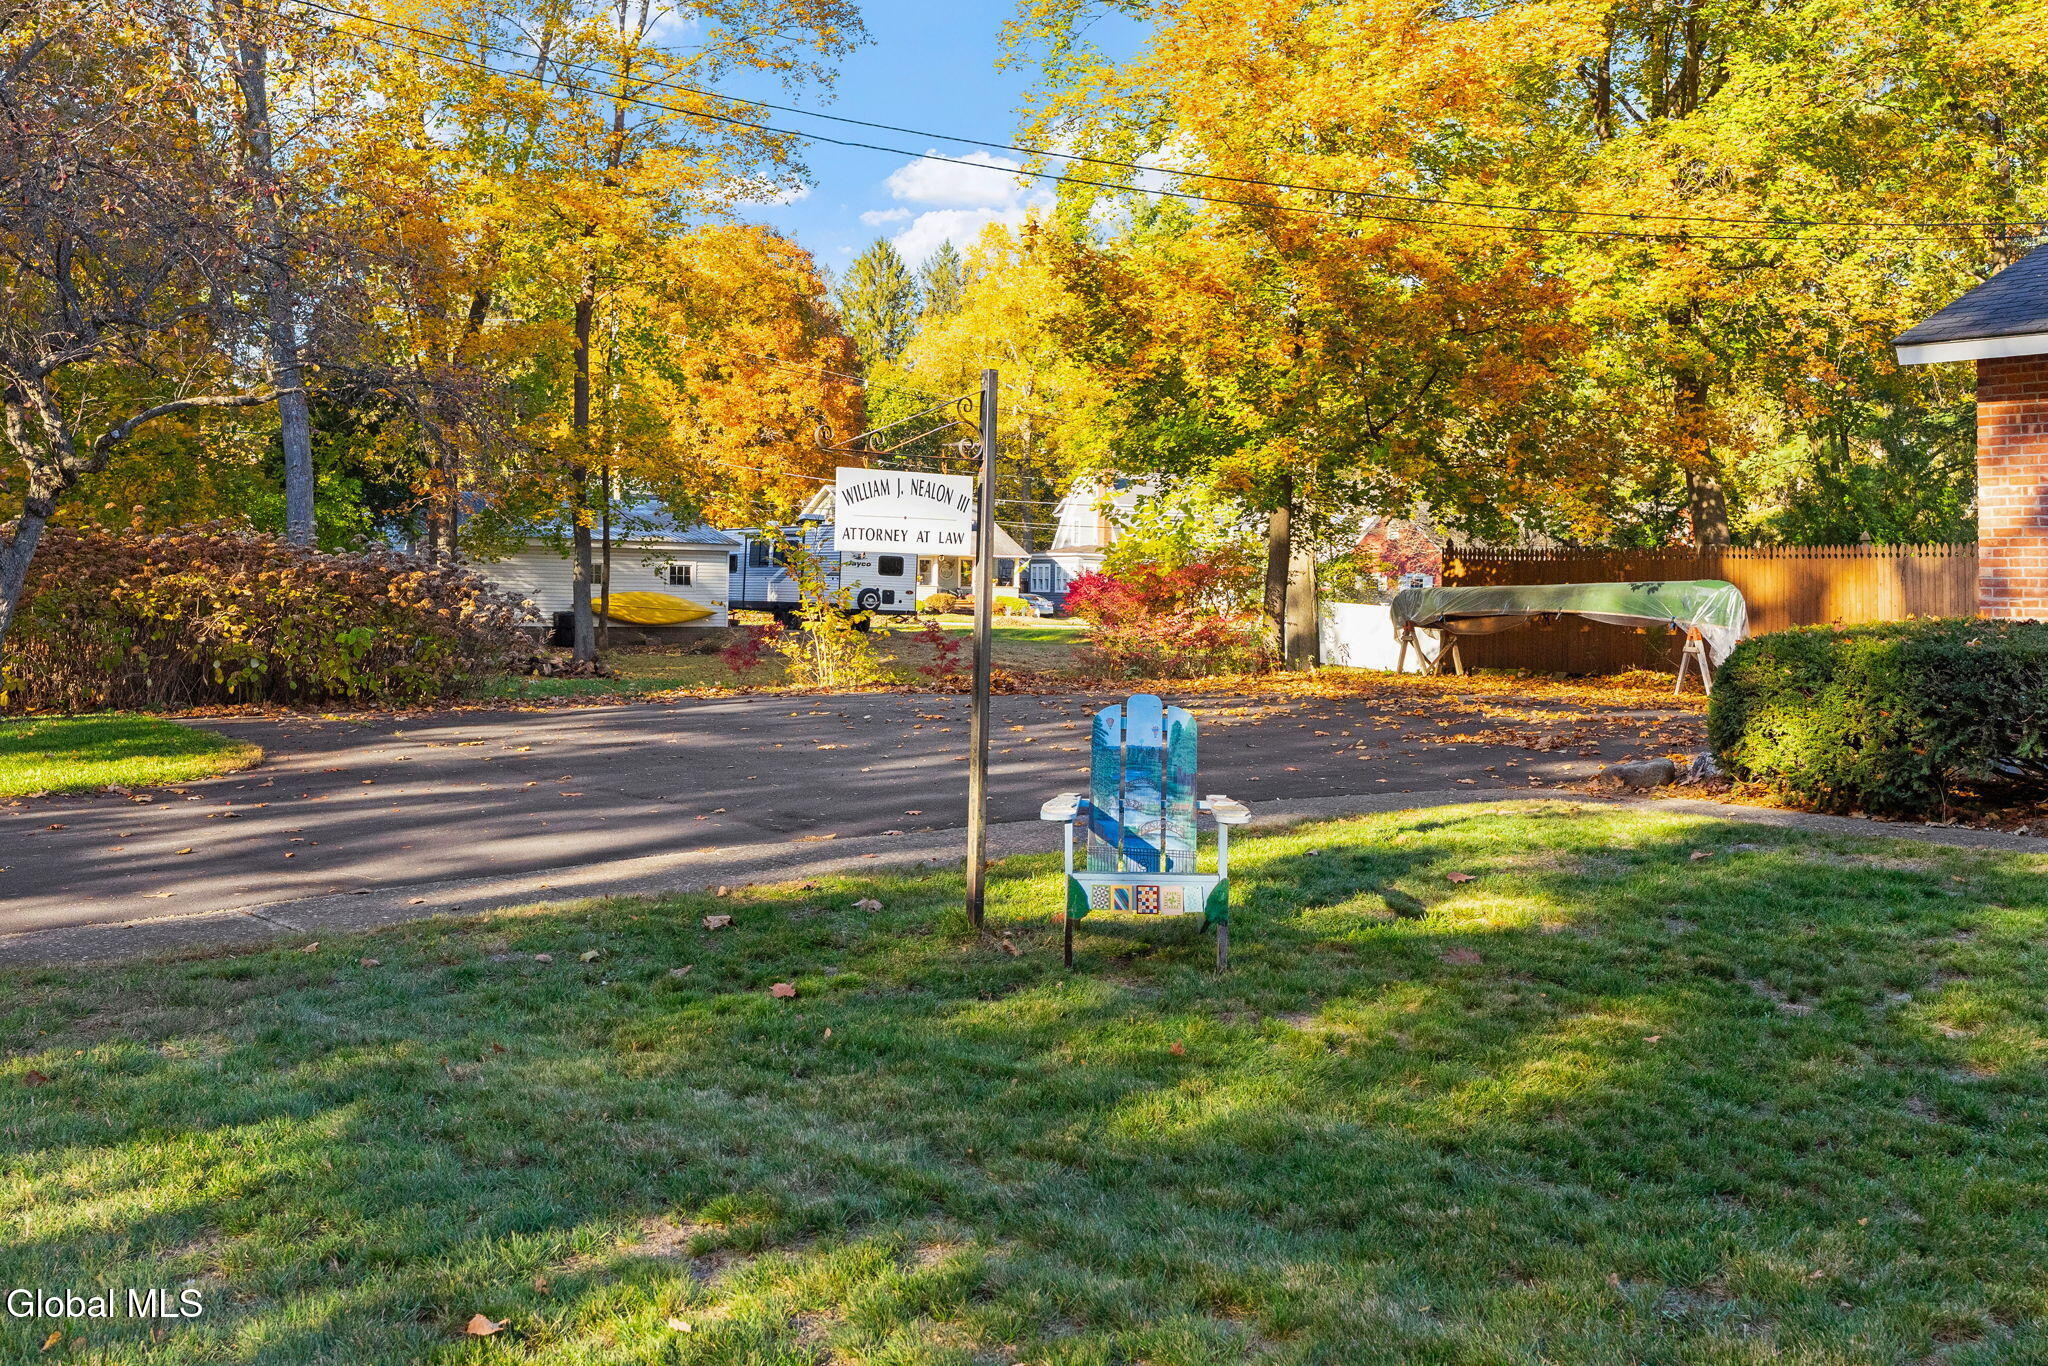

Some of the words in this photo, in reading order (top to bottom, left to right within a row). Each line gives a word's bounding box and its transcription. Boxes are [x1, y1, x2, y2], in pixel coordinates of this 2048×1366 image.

[841, 478, 890, 506] WILLIAM
[897, 477, 904, 499] J.
[910, 478, 954, 505] NEALON
[956, 494, 971, 513] III
[842, 527, 908, 542] ATTORNEY
[916, 530, 931, 543] AT
[938, 531, 965, 545] LAW
